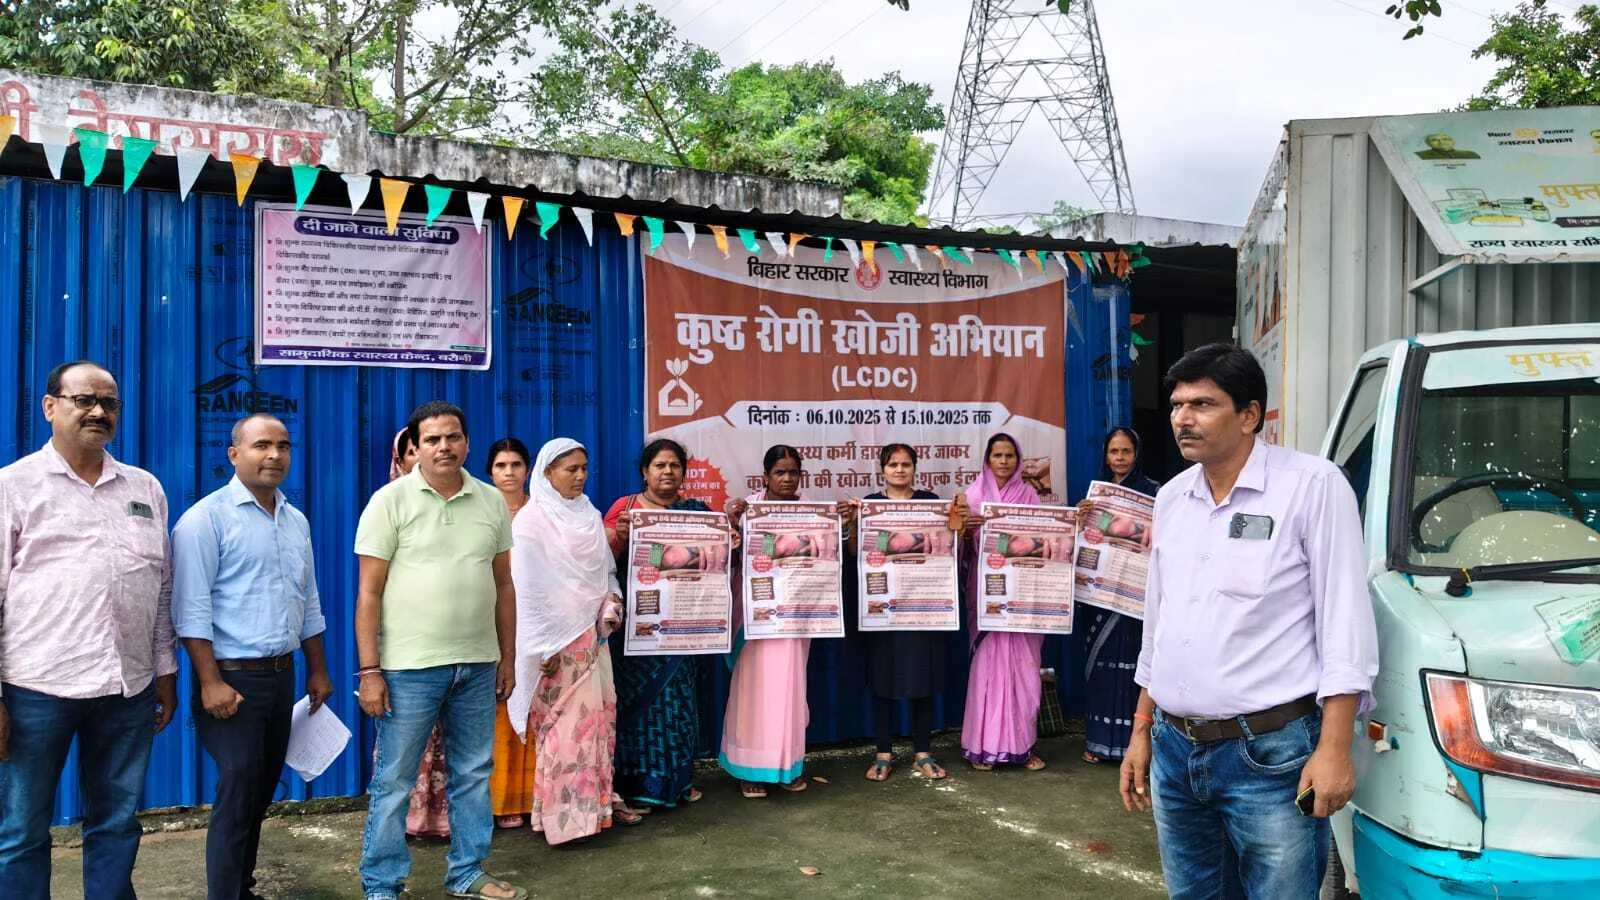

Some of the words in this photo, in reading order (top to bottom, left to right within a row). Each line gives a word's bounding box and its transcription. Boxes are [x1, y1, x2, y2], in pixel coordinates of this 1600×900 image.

[302, 218, 320, 231] दी
[324, 221, 359, 234] जाने
[1468, 240, 1506, 248] राज्य
[1509, 239, 1567, 248] स्वास्थ्य
[747, 255, 792, 279] बिहार
[794, 265, 850, 282] सरकार
[888, 270, 940, 287] स्वास्थ्य
[942, 269, 989, 289] विभाग
[674, 312, 748, 365] कुष्ठ
[755, 304, 823, 353] रोगी
[831, 308, 921, 356] खोजी
[929, 314, 1047, 358] अभियान
[278, 349, 350, 359] सामुदायिक
[353, 351, 398, 360] स्वास्थ्य
[832, 365, 917, 393] (LCDC)
[747, 405, 792, 425] दिनांक
[806, 409, 880, 424] 06.10.2025
[885, 405, 896, 425] से
[901, 409, 969, 424] 15.10.2025
[972, 410, 992, 425] तक
[826, 441, 857, 460] कर्मी
[934, 445, 970, 460] जाकर
[814, 469, 832, 488] की
[837, 468, 871, 488] खोज
